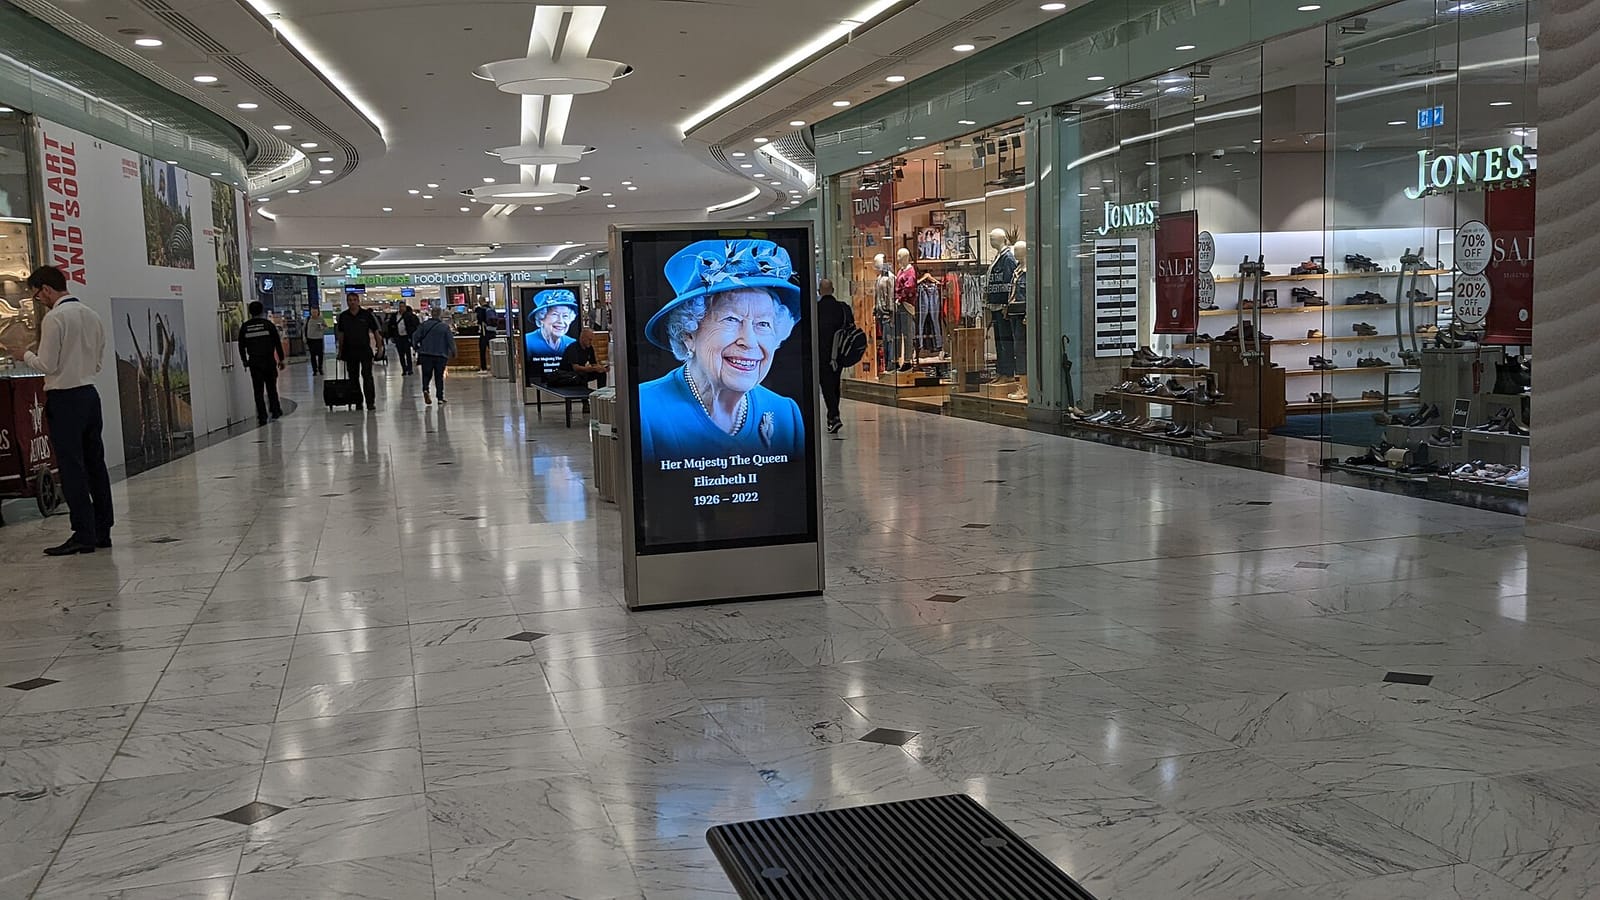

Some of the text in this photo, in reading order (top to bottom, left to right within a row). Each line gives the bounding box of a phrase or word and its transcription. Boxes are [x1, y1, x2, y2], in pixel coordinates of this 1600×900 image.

[43, 132, 63, 195] ART
[1404, 144, 1525, 200] JONES
[60, 142, 87, 286] AND SOUL
[1098, 201, 1156, 236] JONES
[1461, 233, 1485, 247] 70%
[1464, 248, 1482, 257] OFF
[1158, 257, 1194, 277] SALE
[1457, 282, 1486, 298] 20%
[1459, 306, 1482, 316] SALE
[660, 454, 788, 471] Her Majesty The Queen
[694, 473, 757, 487] Elizabeth II
[693, 494, 720, 506] 1926
[731, 492, 759, 503] 2022
